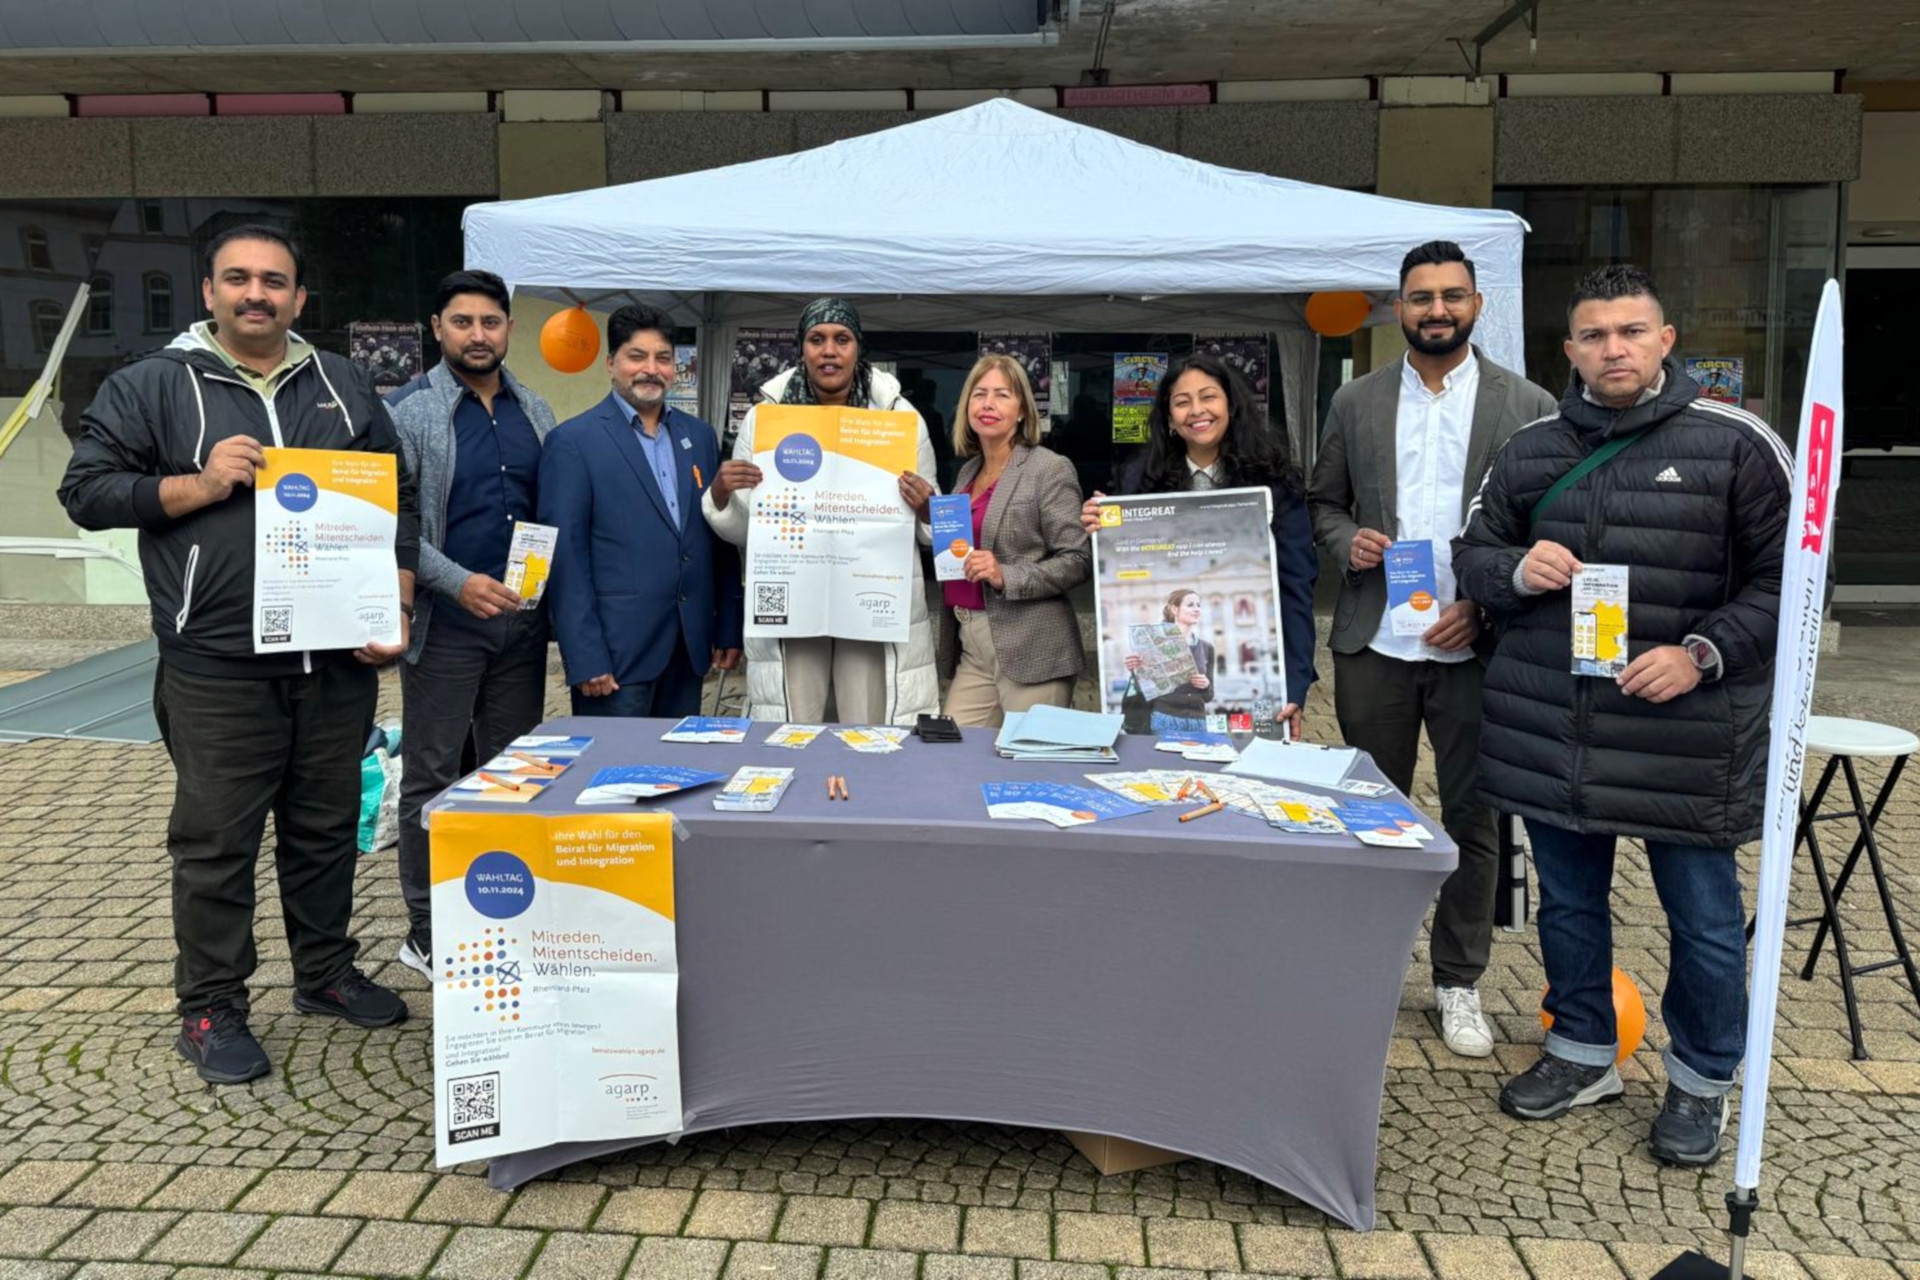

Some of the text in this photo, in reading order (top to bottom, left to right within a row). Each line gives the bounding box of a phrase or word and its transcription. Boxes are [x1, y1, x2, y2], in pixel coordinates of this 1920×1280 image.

[1069, 88, 1175, 102] AUSTROTHERM
[1695, 361, 1734, 369] CIRCUS
[782, 448, 815, 457] WAHLTAG
[814, 490, 867, 501] Mitreden.
[814, 502, 903, 515] Mitentscheiden.
[1122, 506, 1176, 518] INTEGREAT
[814, 514, 858, 525] Wählen.
[315, 523, 358, 532] Mitreden.
[315, 533, 385, 543] Mitentscheiden.
[859, 599, 891, 610] agarp
[554, 829, 642, 840] Ihre Wahl für den
[555, 842, 655, 855] Beirat für Migration
[557, 856, 635, 868] und Integration
[476, 873, 524, 882] WAHLTAG
[477, 886, 524, 896] 10.11.2024
[531, 930, 606, 945] Mitreden.
[532, 946, 658, 963] Mitentscheiden.
[532, 962, 596, 978] Wählen.
[445, 1058, 468, 1067] Gehen
[605, 1083, 650, 1099] agarp
[454, 1125, 495, 1142] SCAN ME
